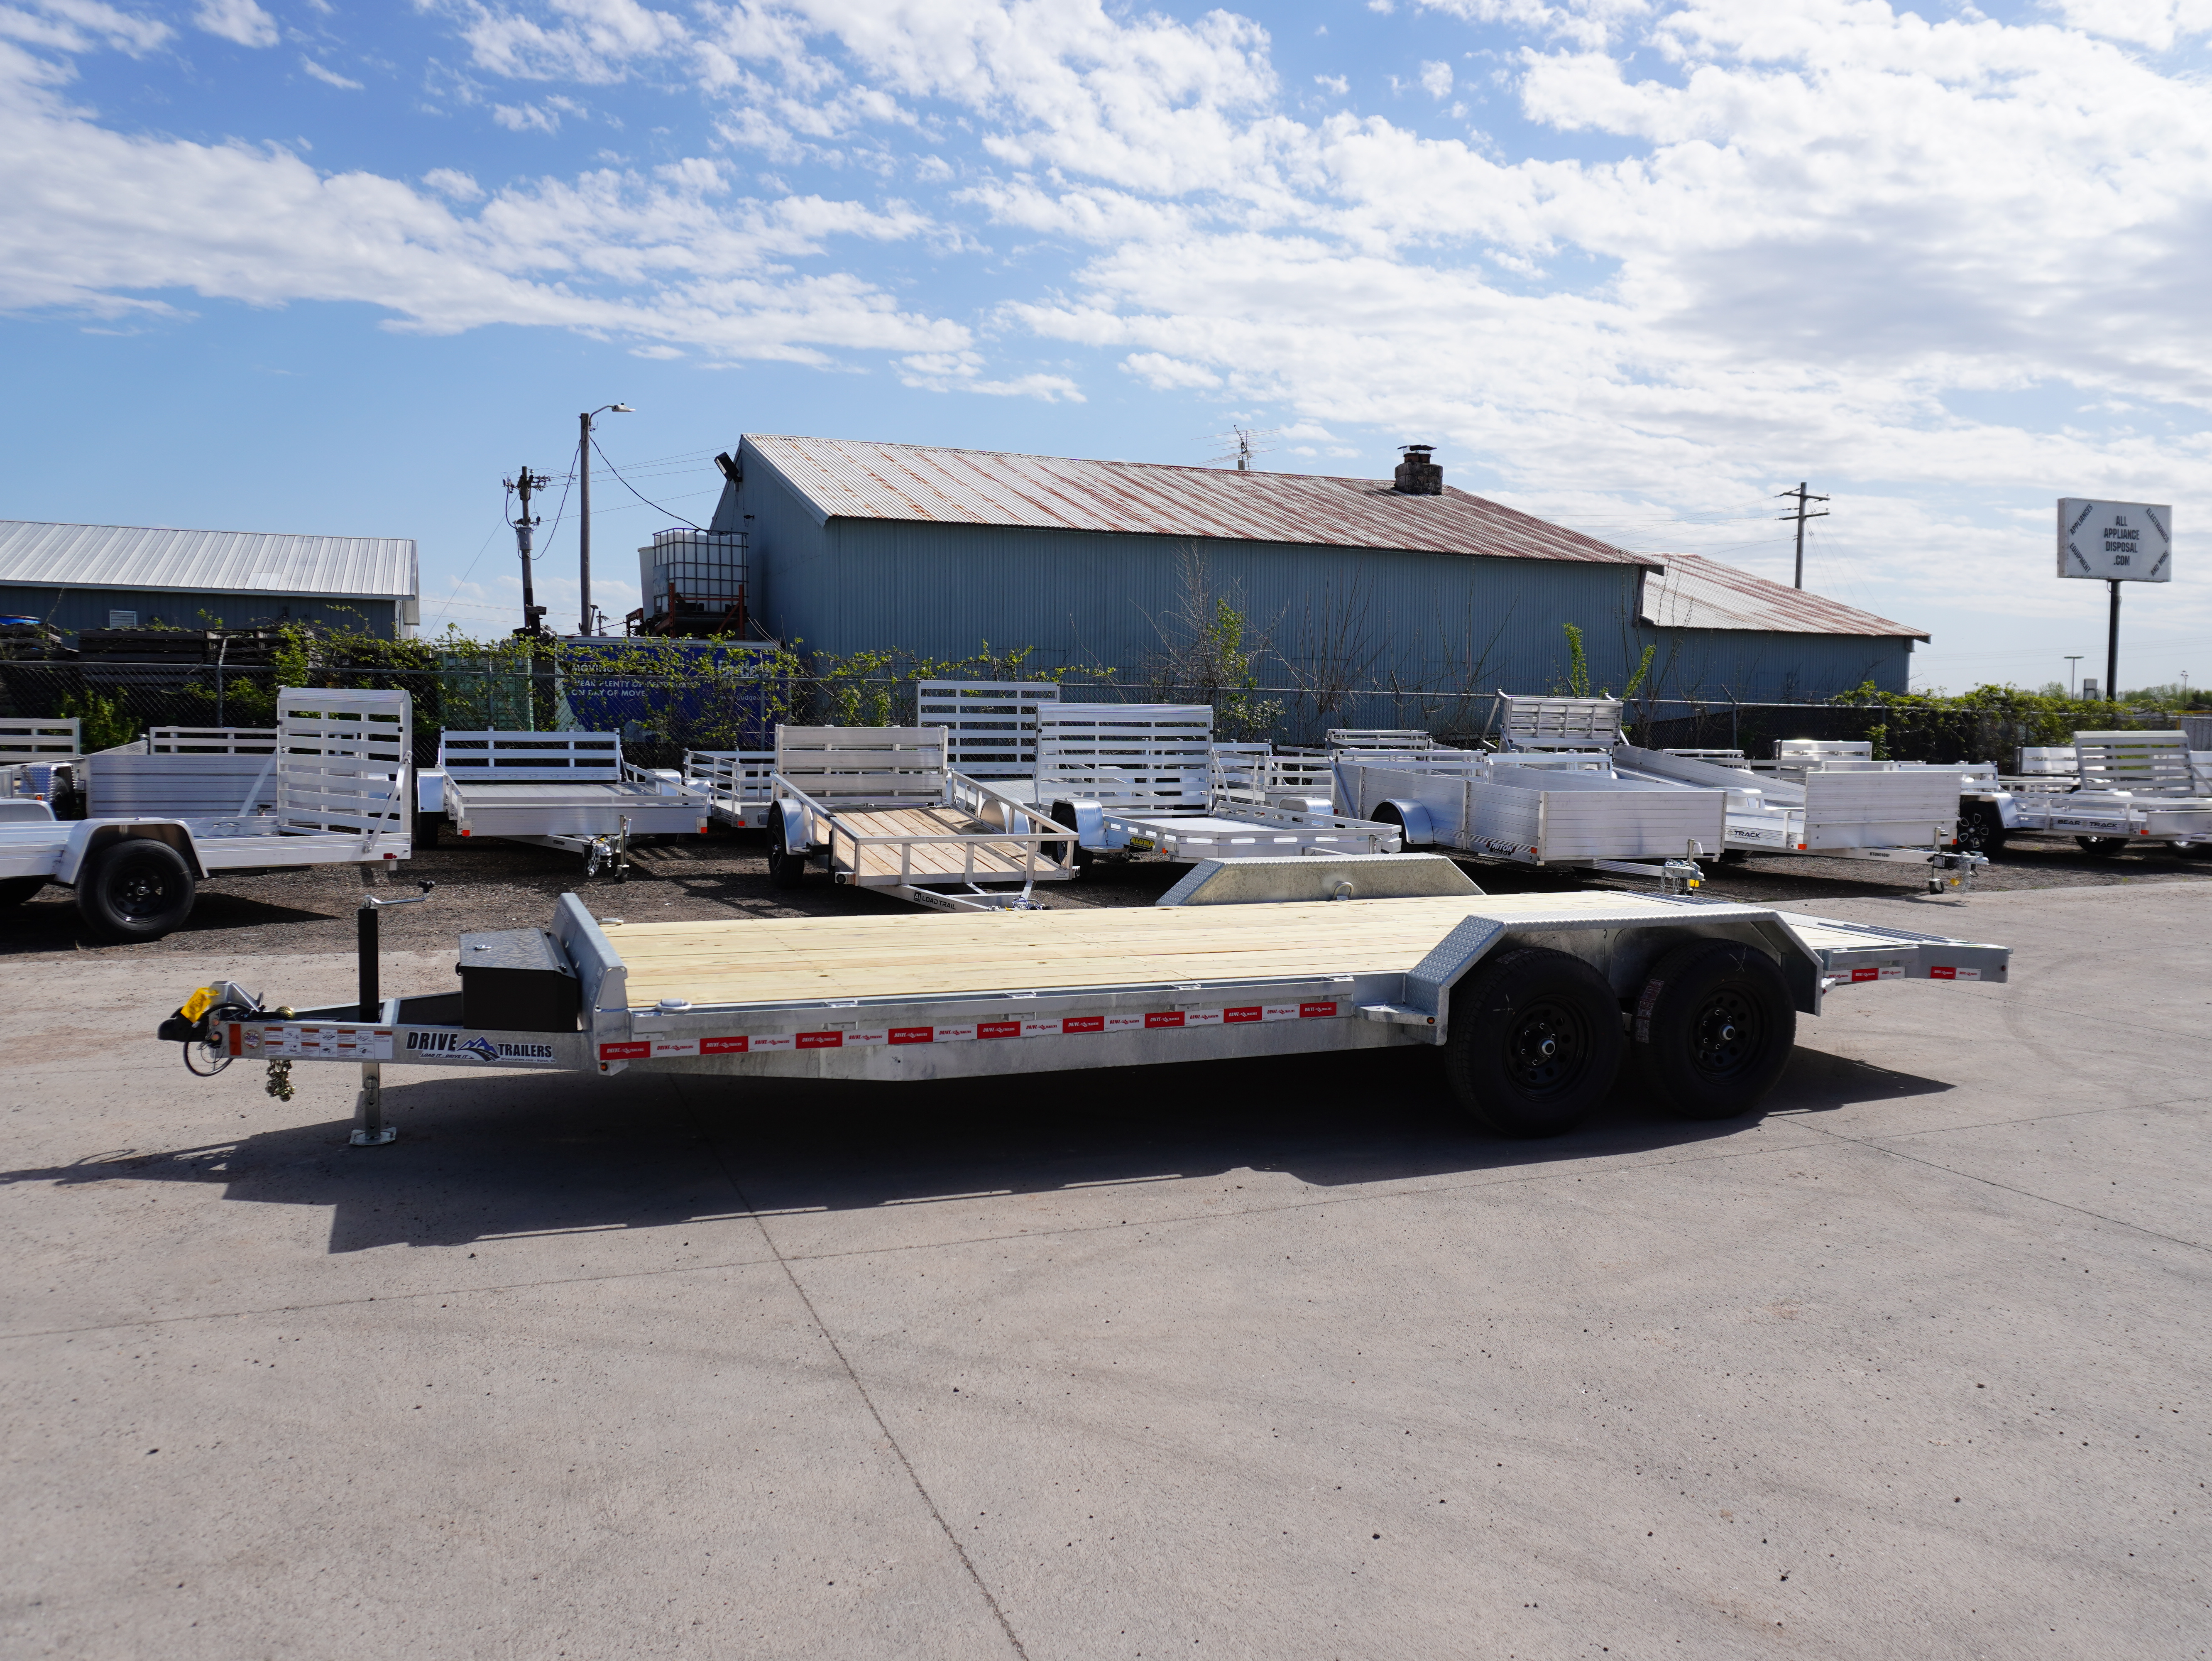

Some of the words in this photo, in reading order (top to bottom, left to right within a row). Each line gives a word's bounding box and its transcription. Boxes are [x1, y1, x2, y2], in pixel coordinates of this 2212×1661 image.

[2070, 504, 2093, 536] APPLIANCES
[2116, 516, 2127, 526] ALL
[2146, 508, 2169, 543] ELECTRONICS
[2104, 528, 2140, 540] APPLIANCE
[2106, 541, 2138, 553] DISPOSAL
[2069, 543, 2092, 573] EQUIPMENT
[2113, 556, 2130, 566] .COM
[2151, 564, 2160, 576] AND
[2158, 550, 2169, 566] MORE
[1130, 836, 1154, 848] ALUMA
[1489, 842, 1514, 852] TRITON
[922, 896, 938, 904] LOAD
[939, 900, 956, 910] TRAIL
[406, 1032, 458, 1051] DRIVE
[498, 1044, 552, 1058] TRAILERS
